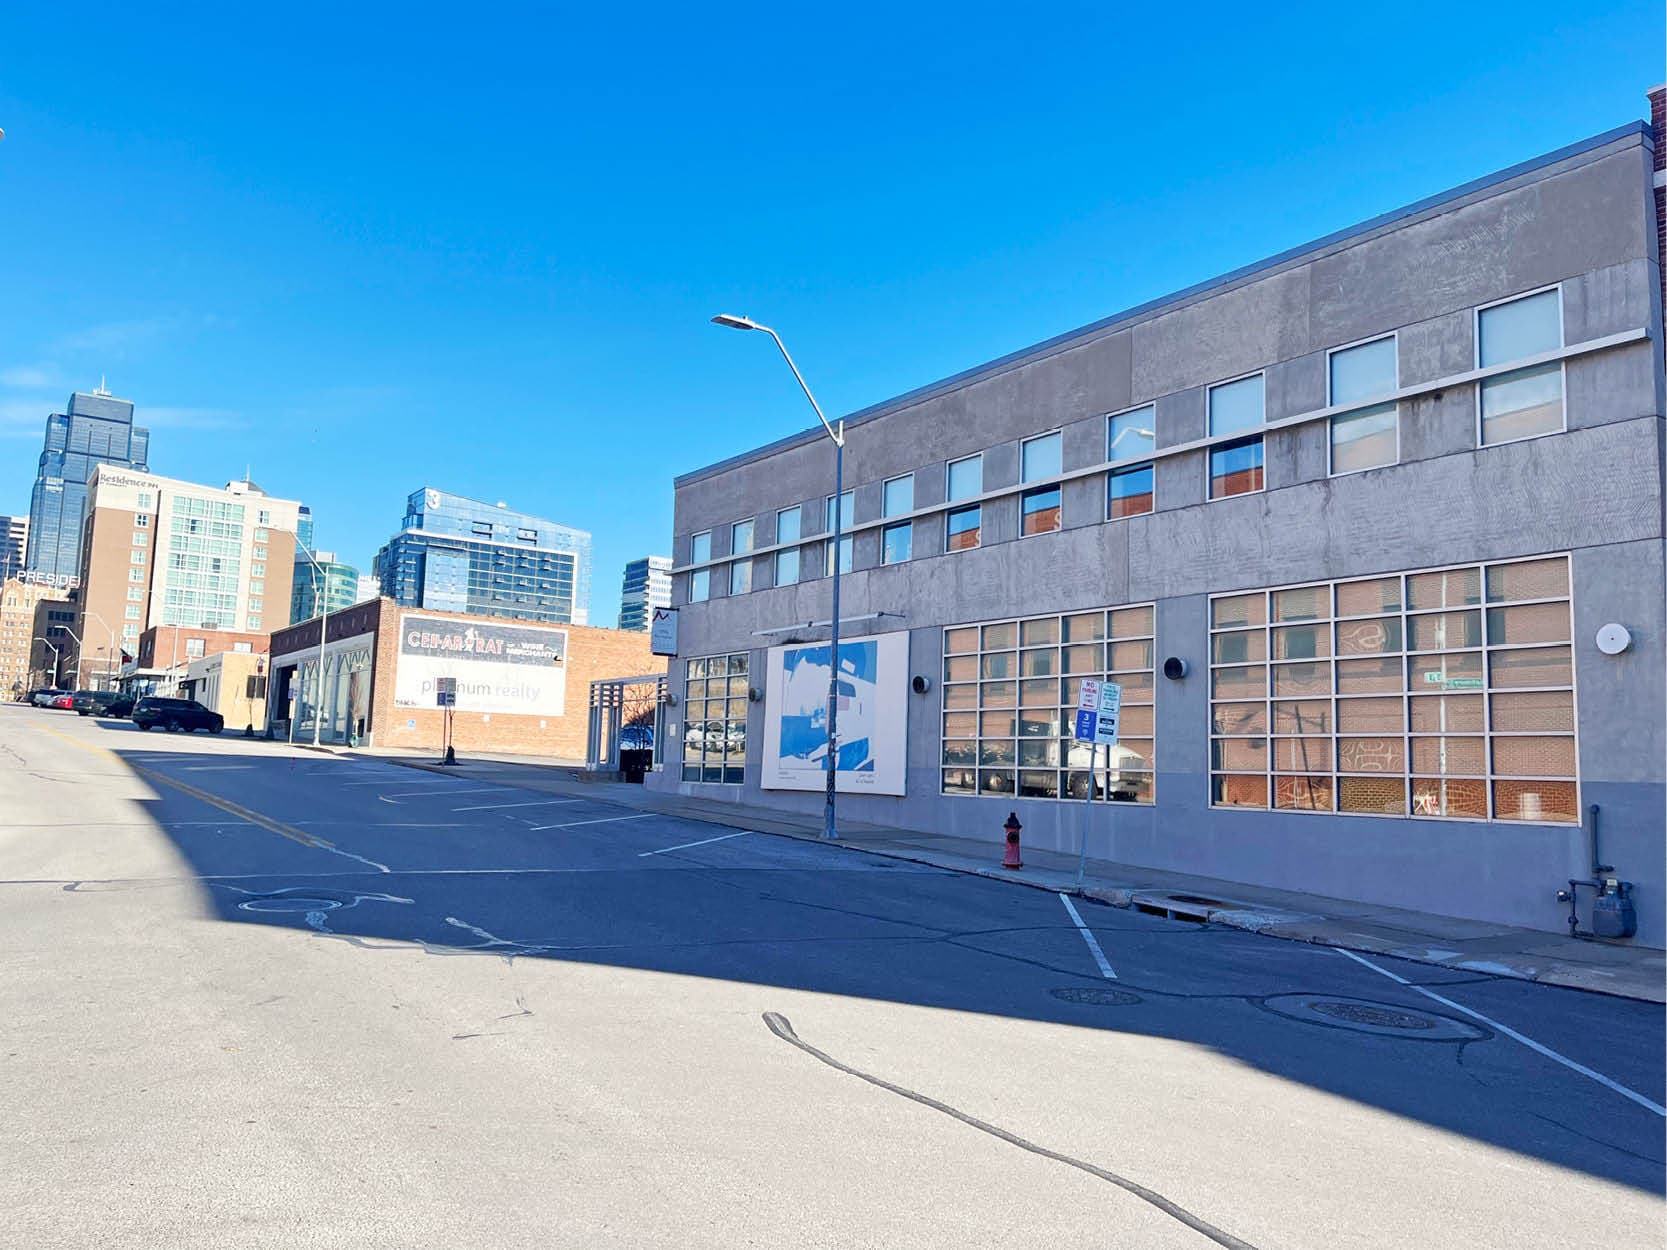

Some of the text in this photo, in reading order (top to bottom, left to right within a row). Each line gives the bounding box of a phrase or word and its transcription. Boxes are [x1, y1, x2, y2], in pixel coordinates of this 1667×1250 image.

[100, 474, 147, 487] Residence
[17, 570, 80, 587] PRESIDE
[475, 638, 504, 654] RAT
[422, 677, 541, 701] plnum realty
